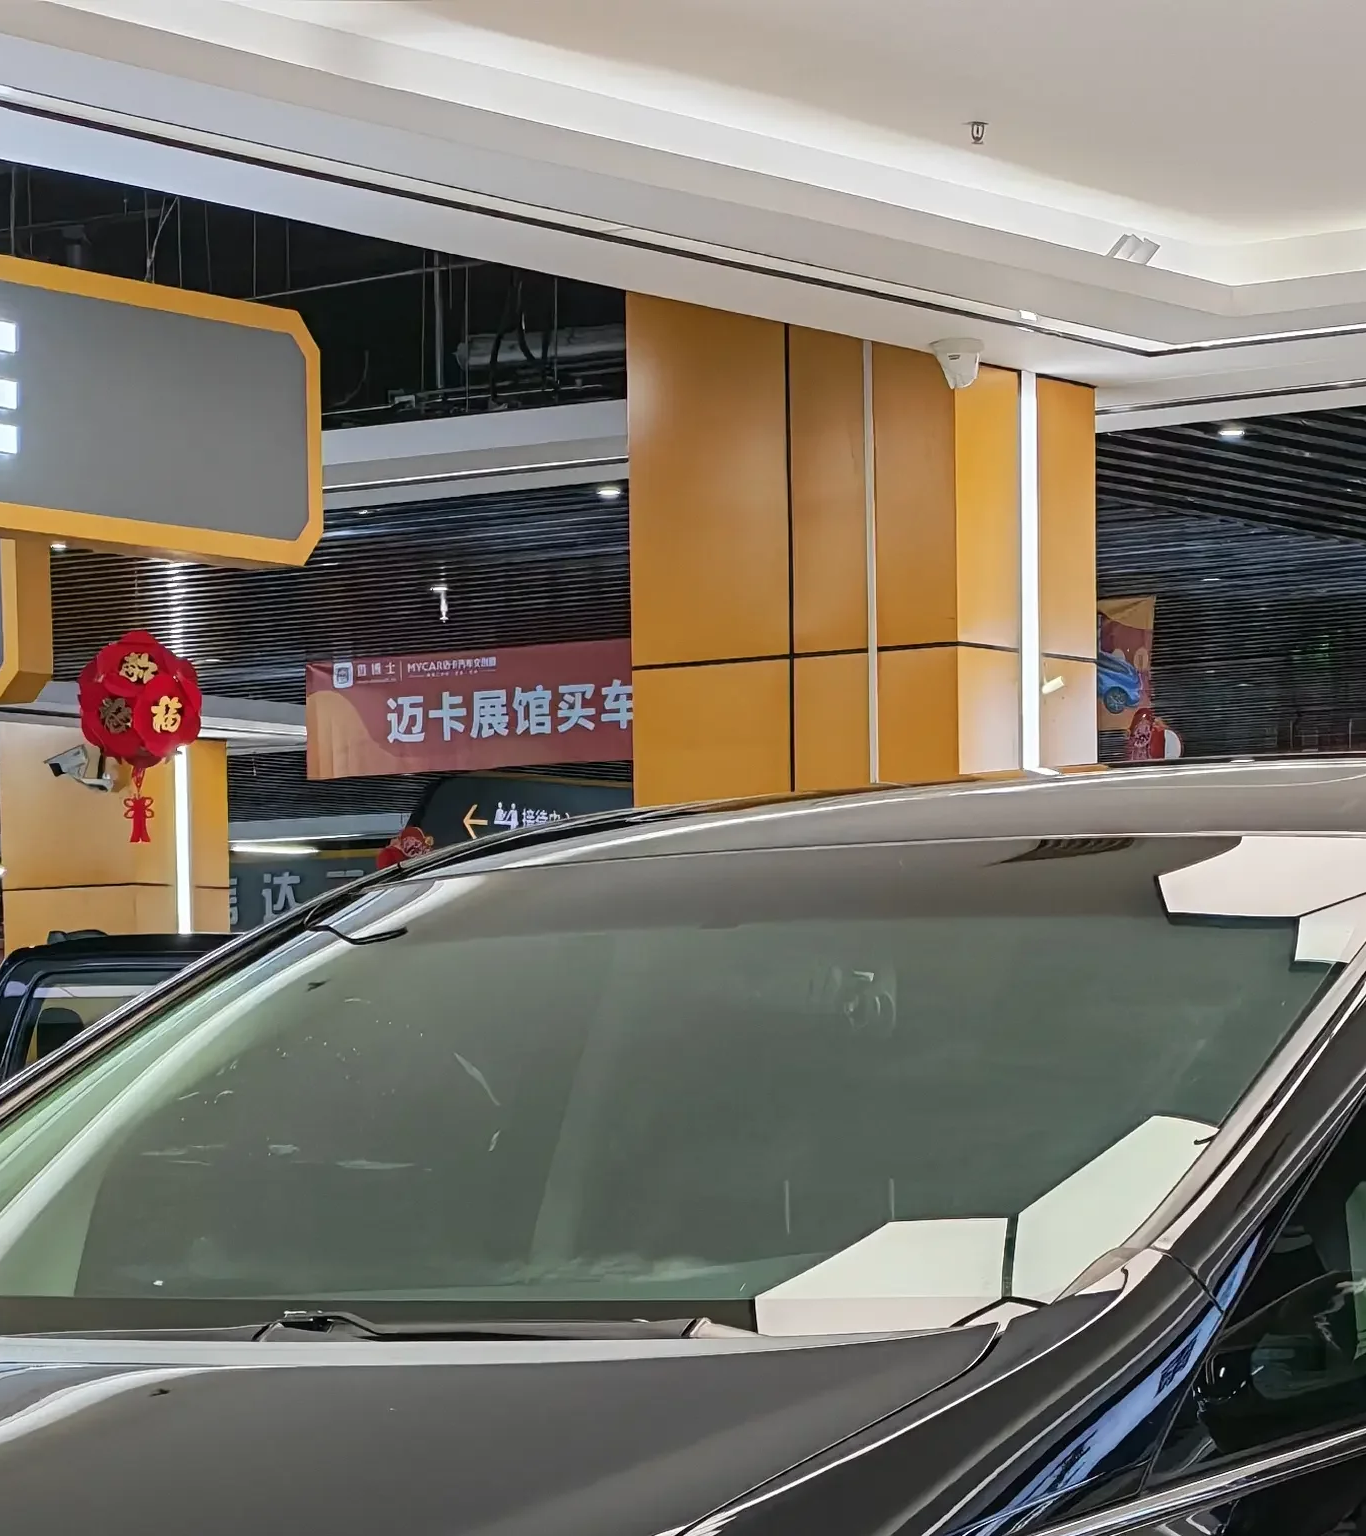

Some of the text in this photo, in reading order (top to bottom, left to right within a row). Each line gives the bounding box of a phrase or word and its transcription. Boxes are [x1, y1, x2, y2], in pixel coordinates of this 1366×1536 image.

[386, 679, 633, 744] 迈卡展馆买车
